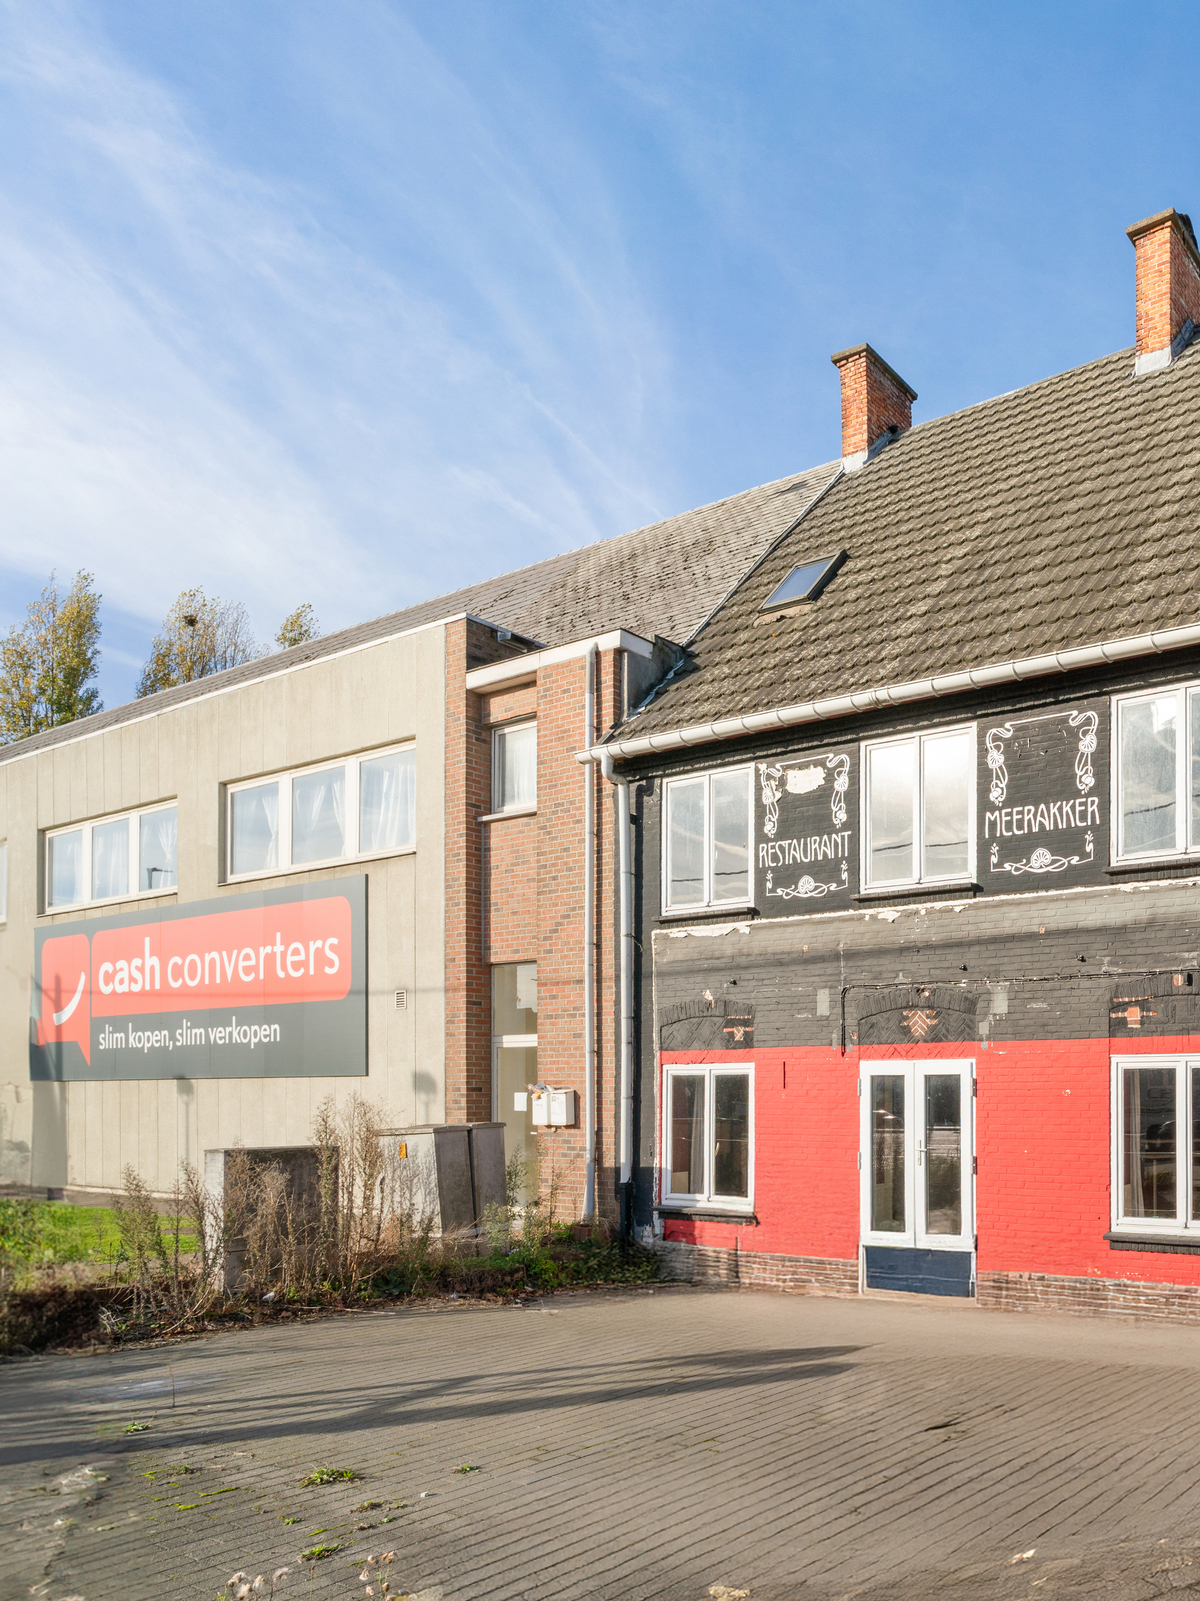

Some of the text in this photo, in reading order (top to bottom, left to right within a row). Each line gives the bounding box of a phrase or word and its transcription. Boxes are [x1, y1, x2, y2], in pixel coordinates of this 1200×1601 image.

[985, 797, 1101, 839] MEERAKKER
[759, 831, 852, 868] RESTAURANT
[98, 932, 340, 995] cash converters
[98, 1016, 281, 1053] slim kopen, slim verkopen
